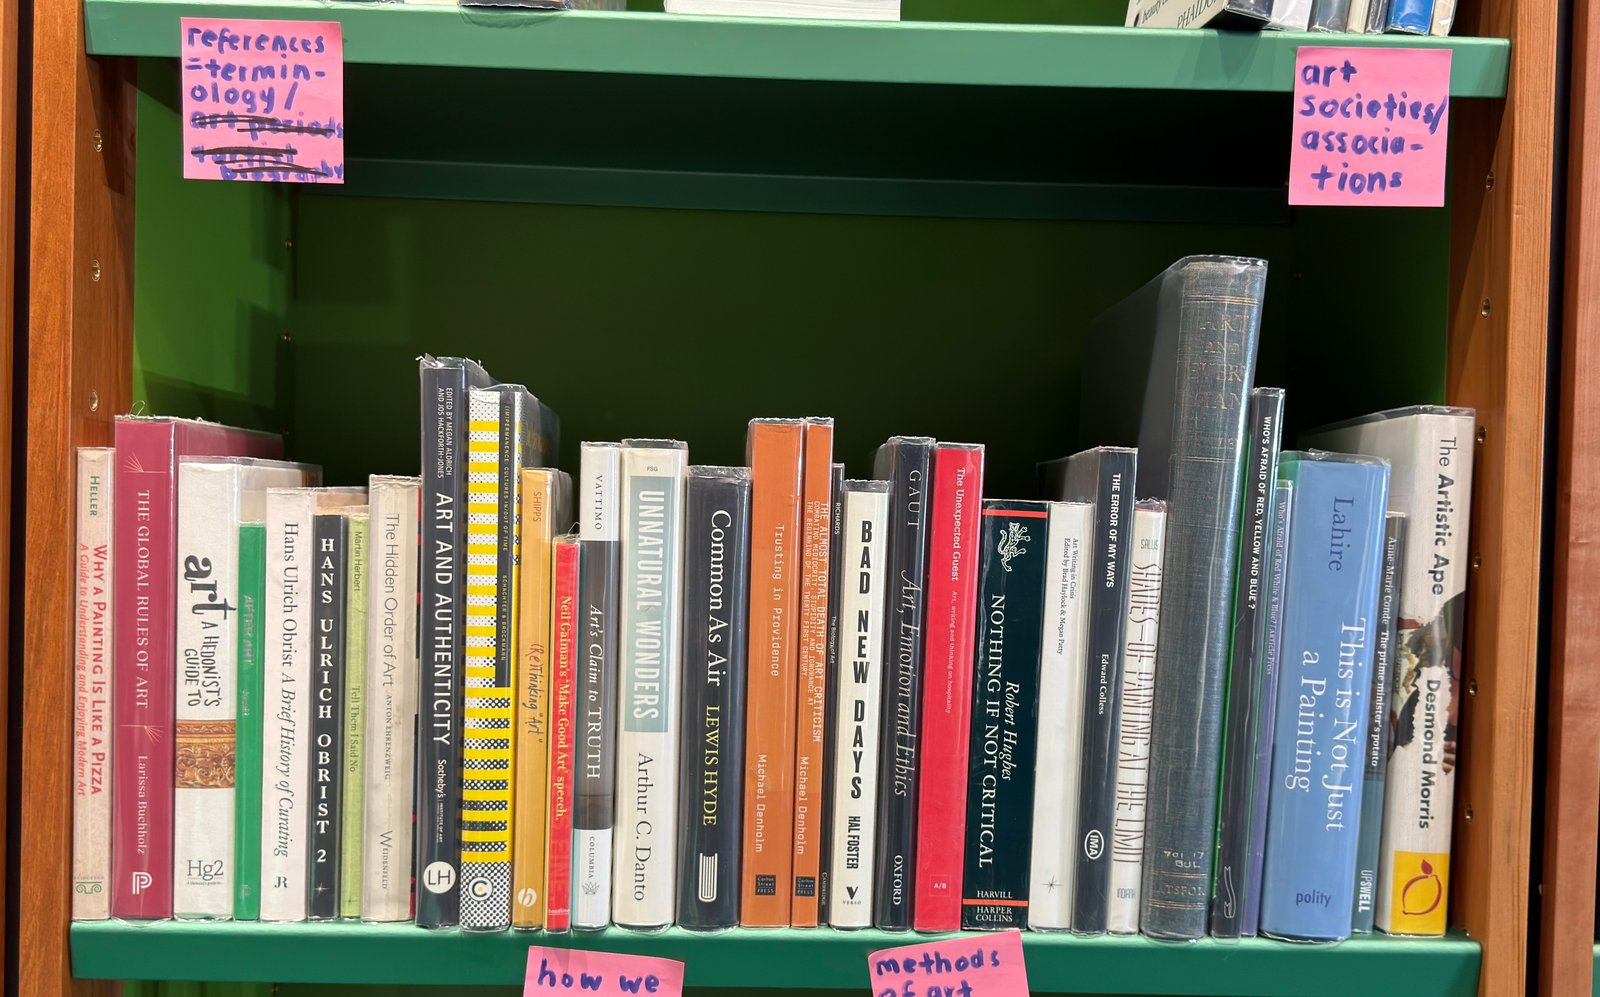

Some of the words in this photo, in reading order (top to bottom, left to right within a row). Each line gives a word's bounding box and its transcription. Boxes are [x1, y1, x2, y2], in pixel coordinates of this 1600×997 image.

[187, 27, 325, 54] references
[1302, 60, 1358, 87] art
[1299, 91, 1448, 135] societies/
[1301, 127, 1424, 155] associa-
[1310, 162, 1403, 194] tions
[445, 387, 454, 410] EDITED
[445, 411, 454, 420] BY
[445, 422, 454, 446] MEGAN
[1261, 415, 1272, 445] WHO'S
[445, 447, 453, 476] ALDRICH
[1258, 446, 1270, 480] AFRAID
[1437, 436, 1458, 468] The
[956, 467, 967, 487] The
[1110, 473, 1121, 495] THE
[1257, 482, 1266, 495] OF
[137, 489, 150, 522] THE
[435, 492, 454, 533] ART
[593, 474, 604, 531] VATTIMO
[819, 502, 829, 520] THE
[907, 469, 923, 530] GAUT
[1108, 494, 1120, 527] ERROR
[1254, 496, 1265, 517] RED,
[1433, 473, 1455, 547] Artistic
[385, 514, 400, 541] The
[951, 489, 965, 549] Unexpected
[1108, 529, 1117, 541] OF
[1251, 519, 1263, 555] YELLOW
[1327, 495, 1355, 572] Lahire
[79, 543, 89, 552] A
[136, 525, 150, 592] GLOBAL
[283, 522, 300, 562] Hans
[636, 490, 665, 611] UNNATURAL
[772, 524, 785, 581] Trusting
[817, 526, 828, 564] ALMOST
[858, 520, 873, 595] BAD
[1107, 544, 1116, 559] MY
[78, 554, 89, 584] Guide
[320, 538, 335, 605] HANS
[384, 544, 399, 594] Hidden
[434, 540, 454, 585] AND
[709, 509, 732, 612] Common
[950, 551, 962, 581] Guest
[1069, 550, 1078, 573] Writing
[1105, 561, 1115, 589] WAYS
[1249, 557, 1260, 576] AND
[1384, 536, 1398, 594] Anne-Marie
[1427, 553, 1451, 596] Ape
[79, 586, 88, 597] to
[183, 554, 238, 621] art
[282, 566, 299, 614] Ulrich
[772, 587, 784, 601] in
[816, 570, 827, 600] TOTAL
[895, 569, 922, 614] Art,
[1248, 578, 1258, 601] BLUE
[136, 595, 149, 647] RULES
[383, 597, 398, 641] Order
[560, 595, 573, 619] Neil
[589, 604, 604, 637] Art's
[815, 606, 826, 638] DEATH
[948, 606, 957, 628] writing
[1380, 595, 1395, 625] Conde
[76, 600, 89, 671] Understanding
[282, 618, 298, 667] Obrist
[707, 614, 729, 644] As
[770, 607, 783, 678] Providence
[852, 610, 871, 684] NEW
[948, 629, 956, 642] and
[986, 593, 1006, 693] NOTHING
[1378, 631, 1390, 649] The
[136, 650, 149, 672] OF
[382, 644, 397, 660] of
[559, 621, 573, 677] Gaiman's
[588, 643, 603, 684] Claim
[814, 643, 825, 656] OF
[898, 620, 921, 698] Emotion
[947, 643, 956, 669] thinking
[1302, 650, 1321, 666] a
[1336, 617, 1367, 679] This
[78, 673, 88, 693] and
[281, 672, 296, 684] A
[317, 618, 334, 720] ULRICH
[382, 662, 397, 688] Art
[432, 593, 453, 746] AUTHENTICITY
[632, 619, 662, 720] WONDERS
[706, 649, 728, 688] Air
[813, 661, 824, 681] ART
[948, 670, 954, 679] on
[1099, 653, 1110, 684] Edward
[1375, 651, 1389, 682] prime
[135, 676, 148, 710] ART
[276, 688, 296, 724] Brief
[587, 690, 599, 703] to
[944, 680, 954, 715] hospitality
[985, 700, 1001, 718] IF
[1003, 681, 1020, 726] Robert
[1097, 685, 1108, 716] Colless
[1334, 688, 1361, 709] is
[1371, 683, 1387, 733] minister's
[75, 696, 88, 738] Enjoying
[557, 717, 570, 748] Good
[811, 686, 823, 743] CRITICISM
[897, 702, 917, 738] and
[1421, 678, 1442, 765] Desmond
[274, 726, 295, 778] History
[586, 707, 602, 780] TRUTH
[704, 704, 721, 766] LEWIS
[850, 699, 866, 800] DAYS
[983, 723, 999, 769] NOT
[1283, 675, 1327, 793] Painting
[1328, 717, 1359, 771] Not
[1369, 734, 1383, 767] potato
[77, 740, 87, 778] Modern
[894, 742, 916, 798] Ethics
[997, 729, 1018, 782] Hughes
[77, 780, 86, 797] Art
[136, 754, 148, 799] Larissa
[275, 780, 294, 797] of
[315, 733, 332, 835] OBRIST
[434, 759, 447, 799] Sotheby's
[636, 752, 654, 815] Arthur
[755, 754, 768, 799] Michael
[553, 775, 569, 822] speech.
[702, 769, 718, 827] HYDE
[1320, 774, 1353, 832] Just
[1418, 770, 1437, 830] Morris
[136, 801, 148, 855] Buchholz
[273, 797, 293, 858] Curating
[635, 820, 653, 840] C.
[754, 803, 767, 853] Denholm
[847, 815, 862, 833] HAL
[979, 773, 997, 869] CRITICAL
[315, 849, 327, 863] 2
[846, 834, 860, 870] FOSTER
[1088, 833, 1099, 857] IMA
[186, 859, 224, 881] Hg2
[633, 846, 652, 902] Danto
[891, 854, 904, 906] OXFORD
[975, 890, 1014, 900] HARVILL
[1295, 888, 1332, 908] polity
[1357, 869, 1373, 913] UPSWELL
[974, 914, 1014, 923] COLLINS
[975, 906, 1013, 915] HARPER
[537, 958, 602, 991] how
[619, 974, 660, 994] we
[876, 948, 1001, 976] methods
